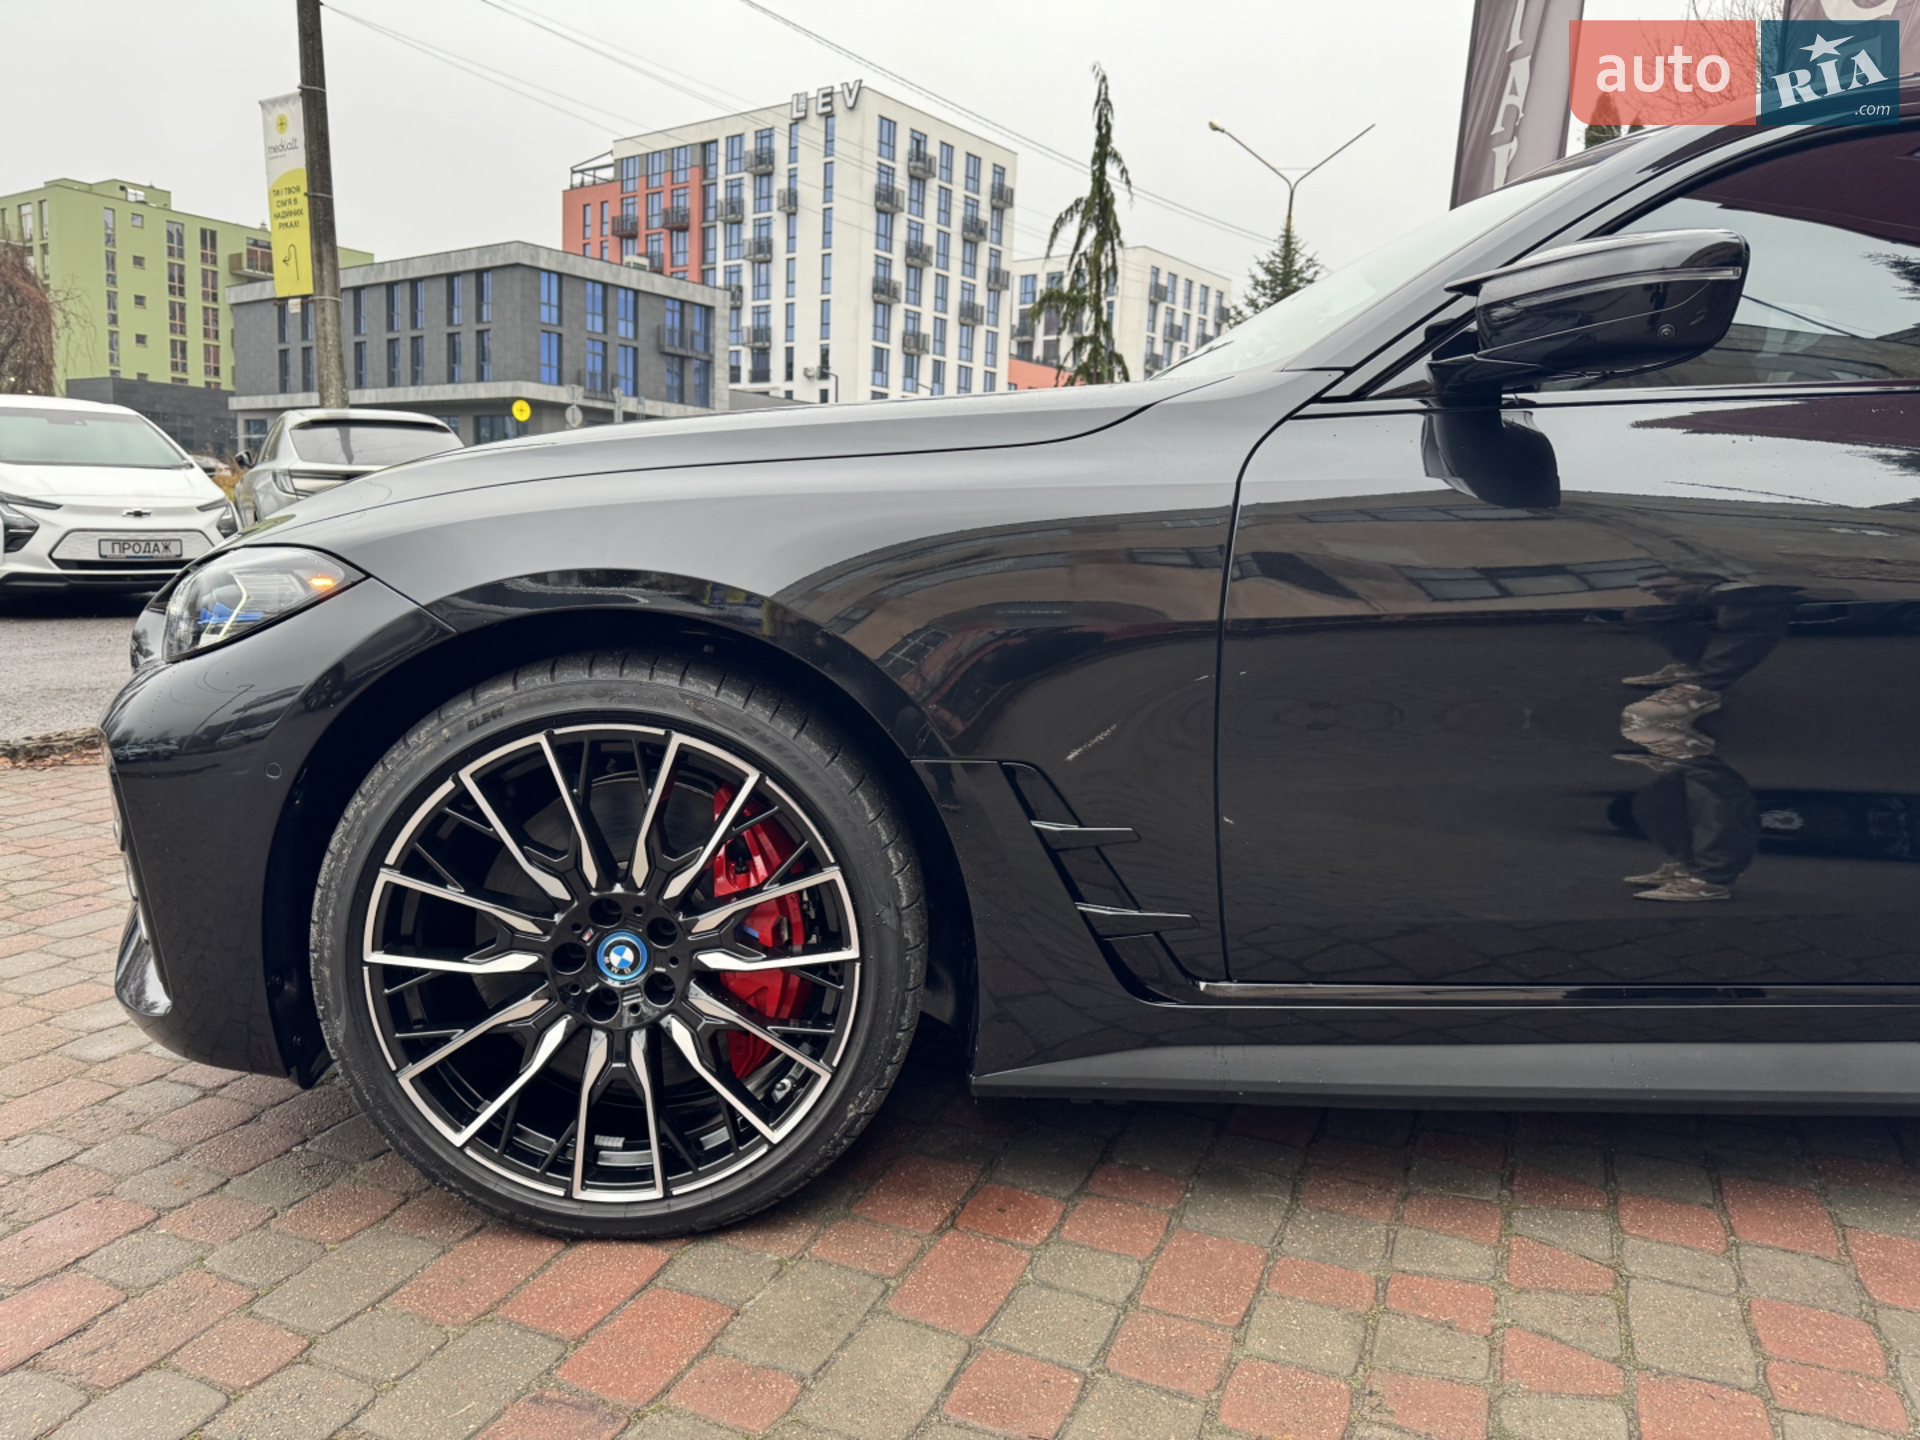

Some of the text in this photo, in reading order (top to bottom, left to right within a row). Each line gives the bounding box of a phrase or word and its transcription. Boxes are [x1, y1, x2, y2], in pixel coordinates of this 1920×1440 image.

[791, 79, 863, 120] LEV
[284, 185, 301, 195] ТВОЯ
[111, 541, 172, 554] ПРОДАЖ
